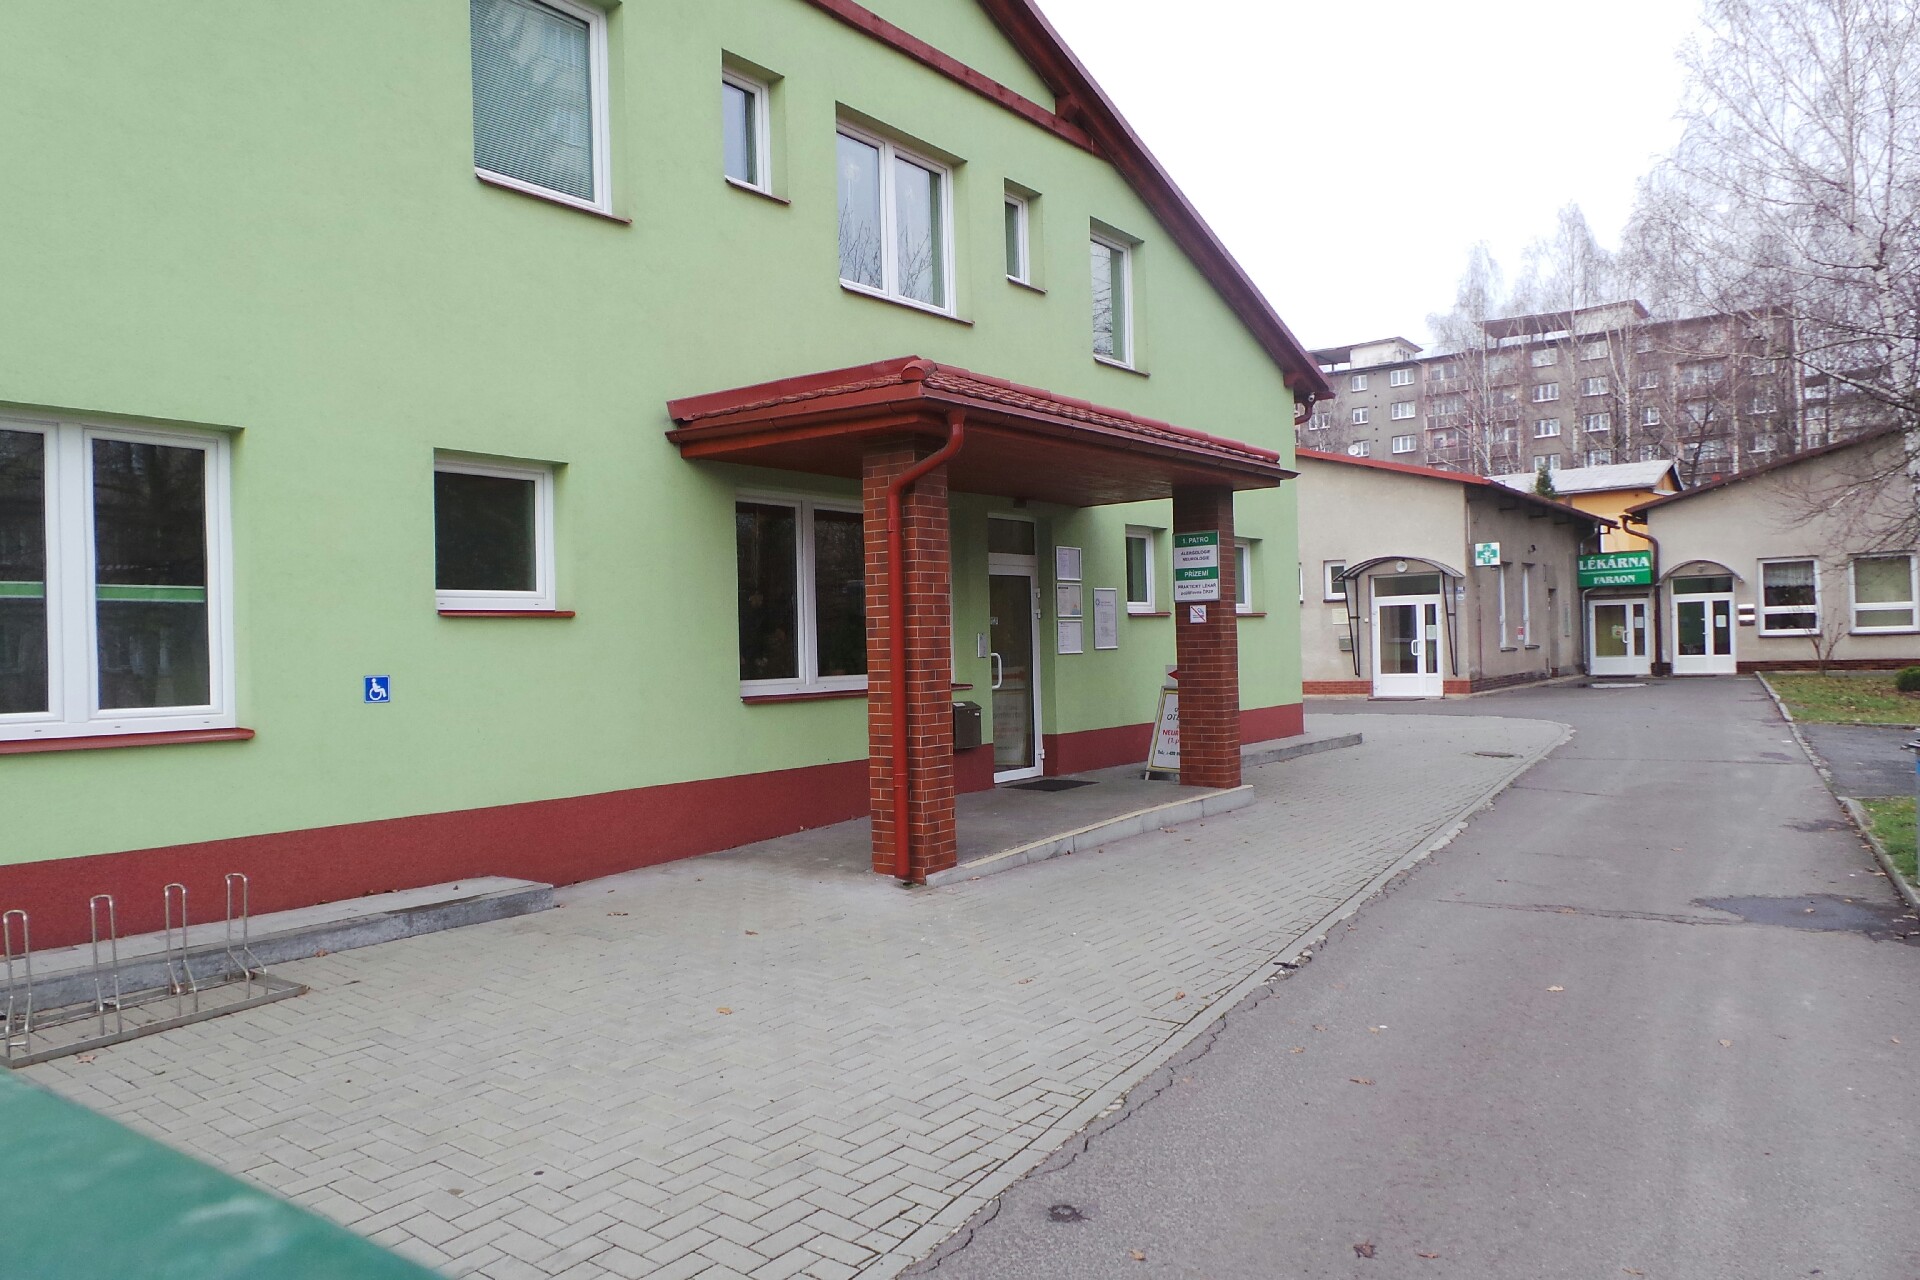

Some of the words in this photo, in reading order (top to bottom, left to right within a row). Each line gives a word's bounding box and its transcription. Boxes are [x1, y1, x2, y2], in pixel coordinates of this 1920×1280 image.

[1579, 555, 1650, 570] LÉKÁRNA
[1184, 570, 1208, 578] PŘÍZEMÍ
[1594, 575, 1635, 584] FARAON
